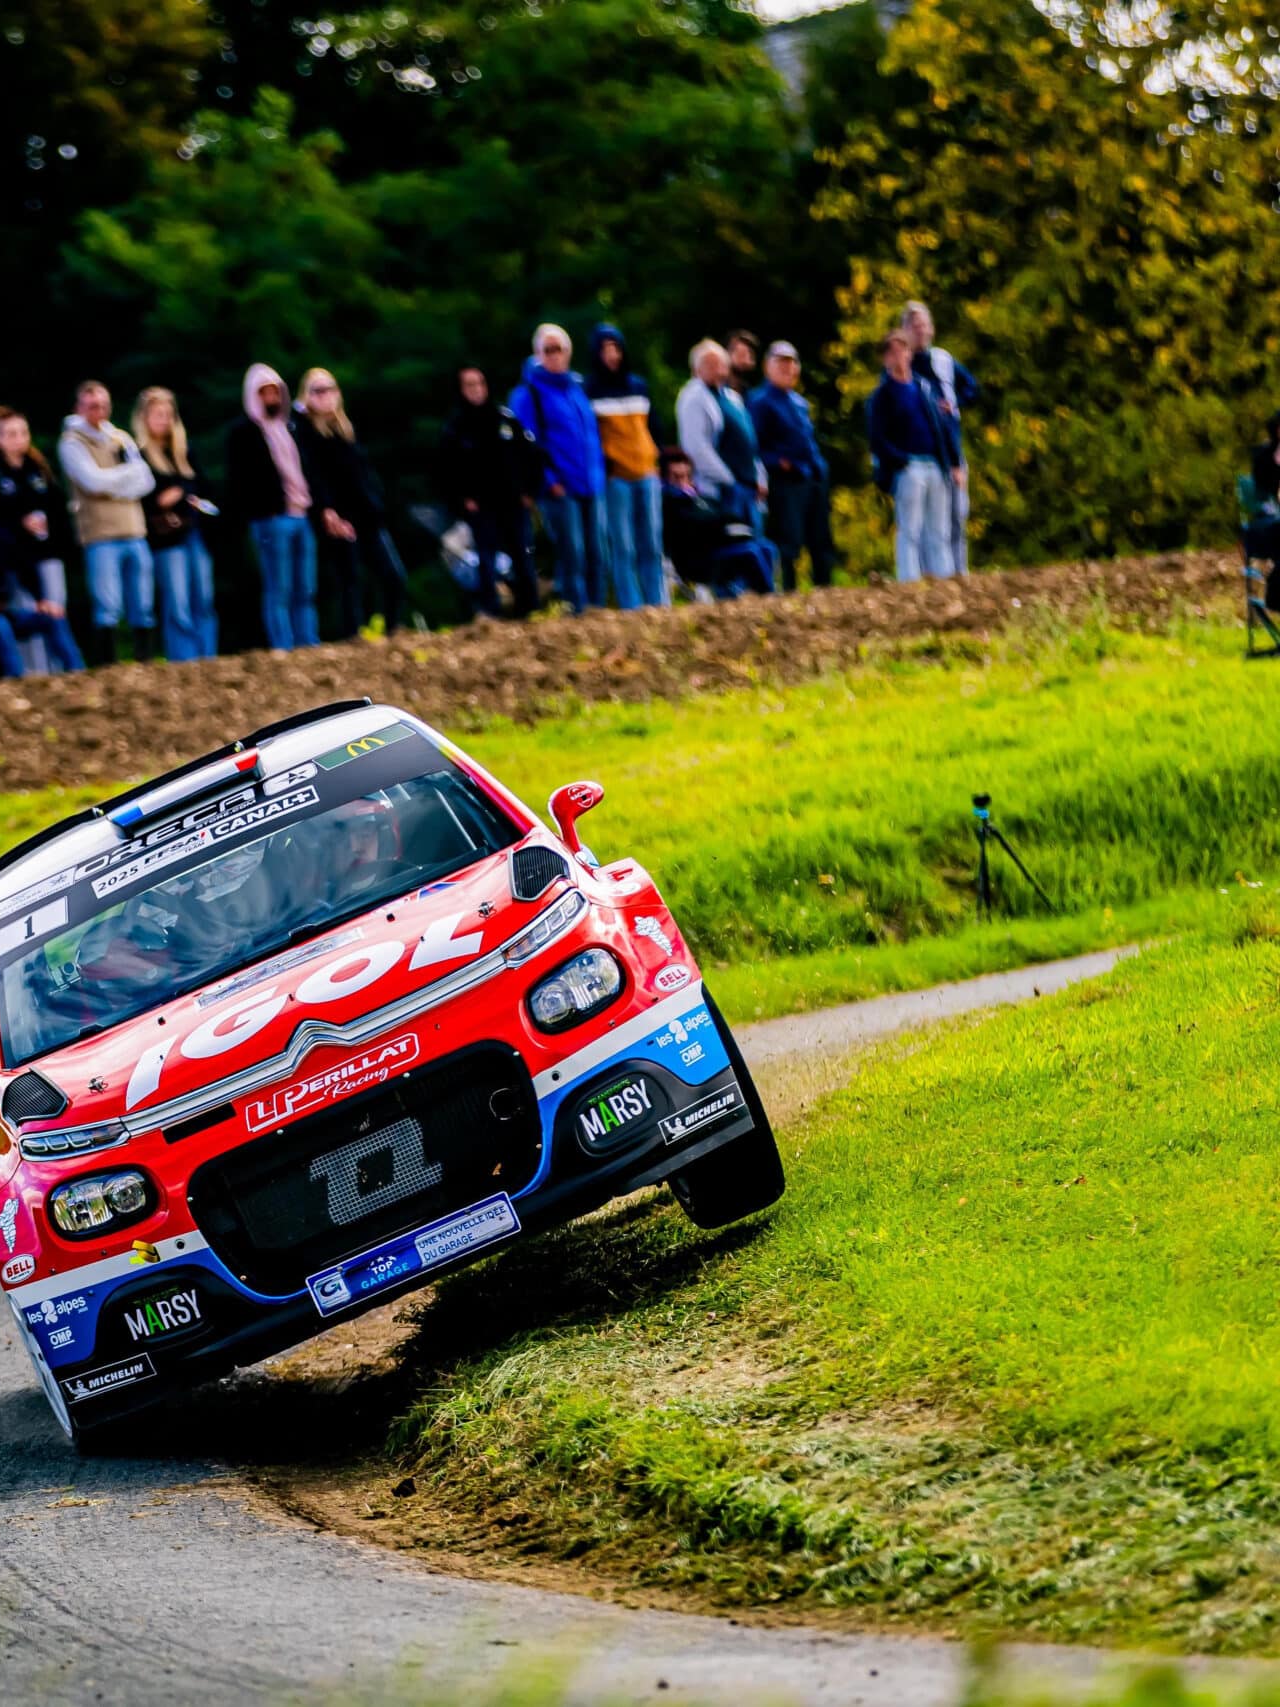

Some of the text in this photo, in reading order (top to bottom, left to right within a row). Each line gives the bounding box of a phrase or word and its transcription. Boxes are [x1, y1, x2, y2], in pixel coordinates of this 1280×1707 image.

[214, 791, 311, 835] CANAL+
[74, 788, 256, 882] ORECA
[97, 865, 138, 893] 2025
[23, 915, 36, 940] 1
[658, 968, 687, 988] BELL
[125, 912, 485, 1111] IGOL
[655, 1031, 674, 1049] les
[683, 1010, 709, 1033] alpes
[681, 1043, 703, 1063] OMP
[323, 1067, 389, 1098] Racing
[579, 1078, 652, 1142] MARSY
[684, 1092, 735, 1127] MICHELIN
[419, 1235, 438, 1250] UNE
[438, 1215, 484, 1242] NOUVELLE
[6, 1260, 32, 1278] BELL
[371, 1260, 394, 1276] TOP
[423, 1247, 438, 1262] DU
[360, 1262, 411, 1290] GARAGE
[26, 1311, 43, 1325] les
[55, 1295, 86, 1315] alpes
[123, 1288, 201, 1341] MARSY
[50, 1328, 73, 1346] OMP
[88, 1362, 144, 1390] MICHELIN
